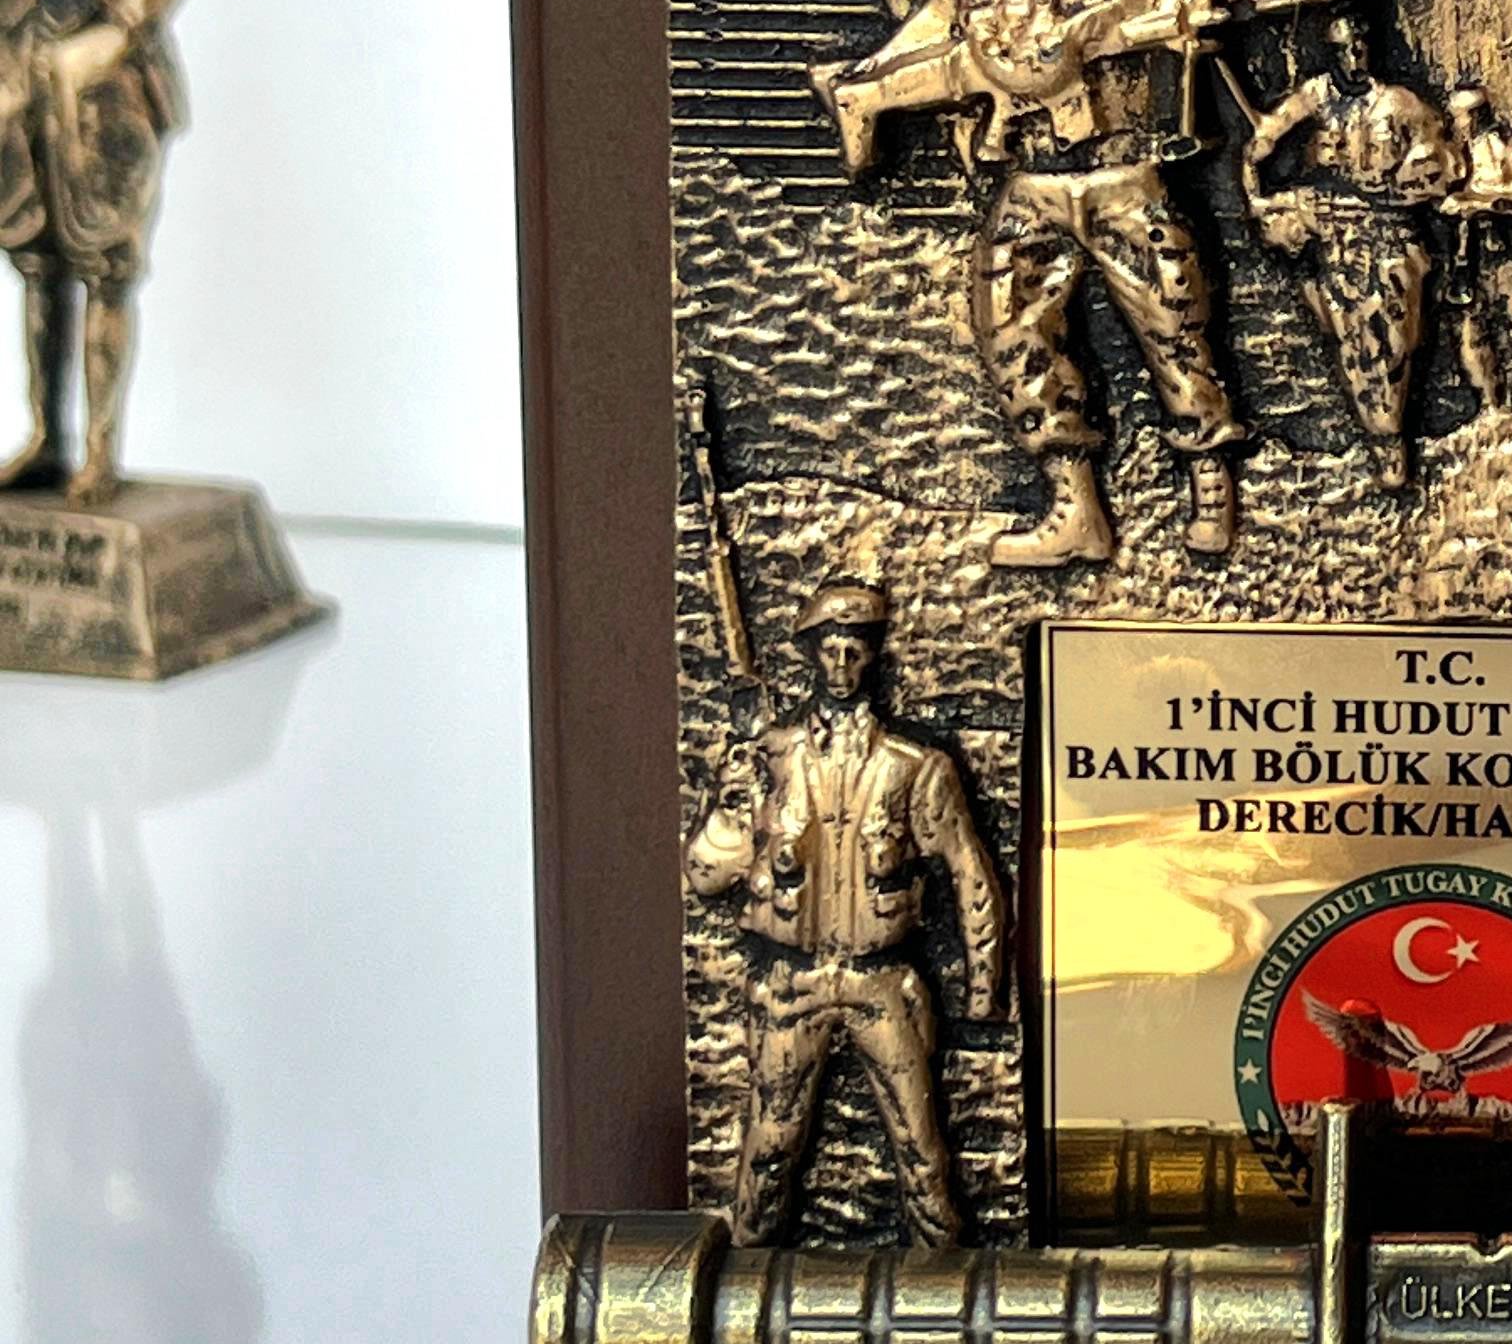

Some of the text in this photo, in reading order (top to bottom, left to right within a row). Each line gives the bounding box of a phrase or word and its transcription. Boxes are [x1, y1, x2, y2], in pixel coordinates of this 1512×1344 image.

[1396, 650, 1486, 686] T.C.
[1167, 689, 1317, 733] 1'İNCİ
[1332, 699, 1511, 737] HUDUT
[1066, 746, 1237, 782] BAKIM
[1252, 740, 1431, 786] BÖLÜK
[1286, 881, 1377, 959] HUDUT
[1381, 870, 1489, 899] TUGAY
